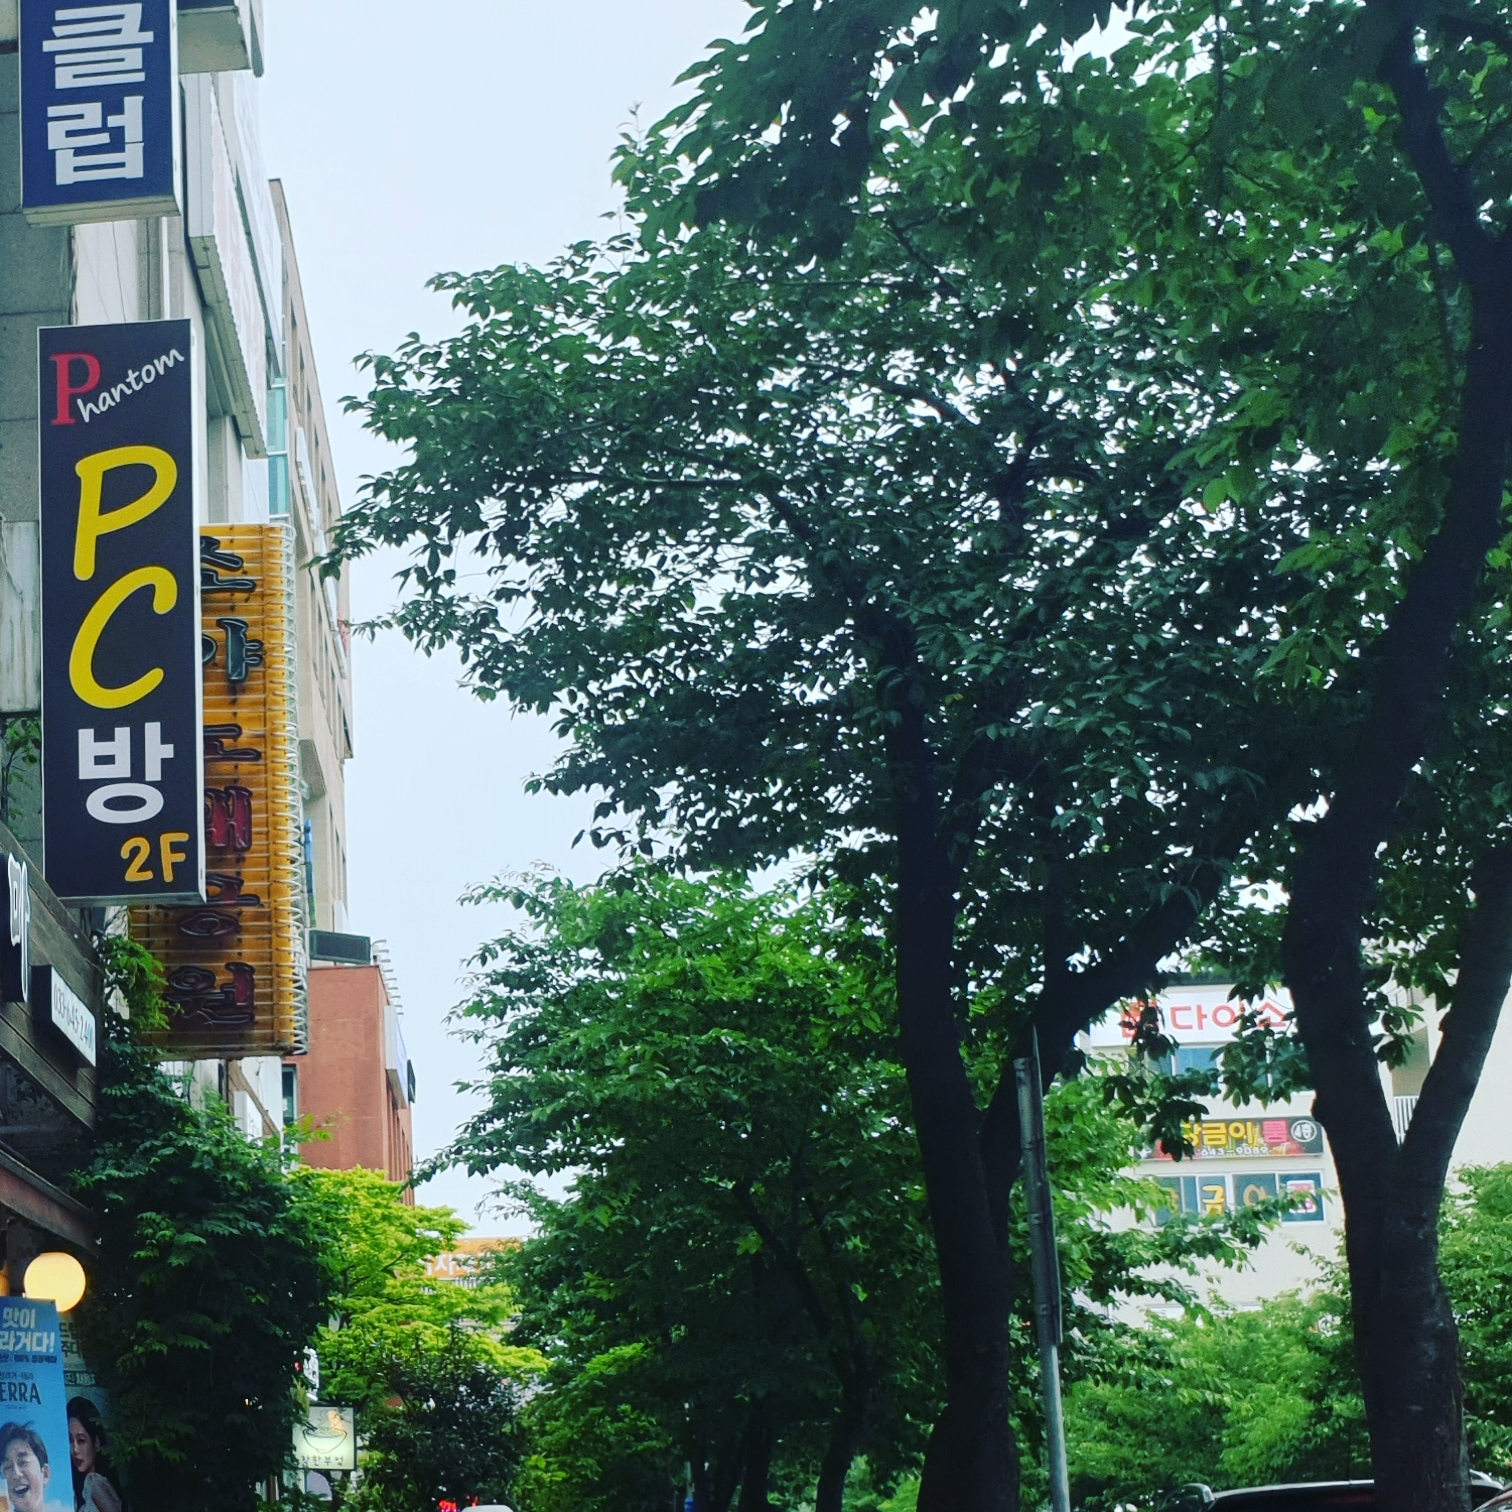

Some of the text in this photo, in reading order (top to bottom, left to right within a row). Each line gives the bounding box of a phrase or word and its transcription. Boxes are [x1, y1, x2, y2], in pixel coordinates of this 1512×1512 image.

[42, 3, 154, 186] 클럽
[50, 347, 185, 426] Phantom
[121, 832, 190, 883] 2F
[2, 1307, 36, 1329] 맛이
